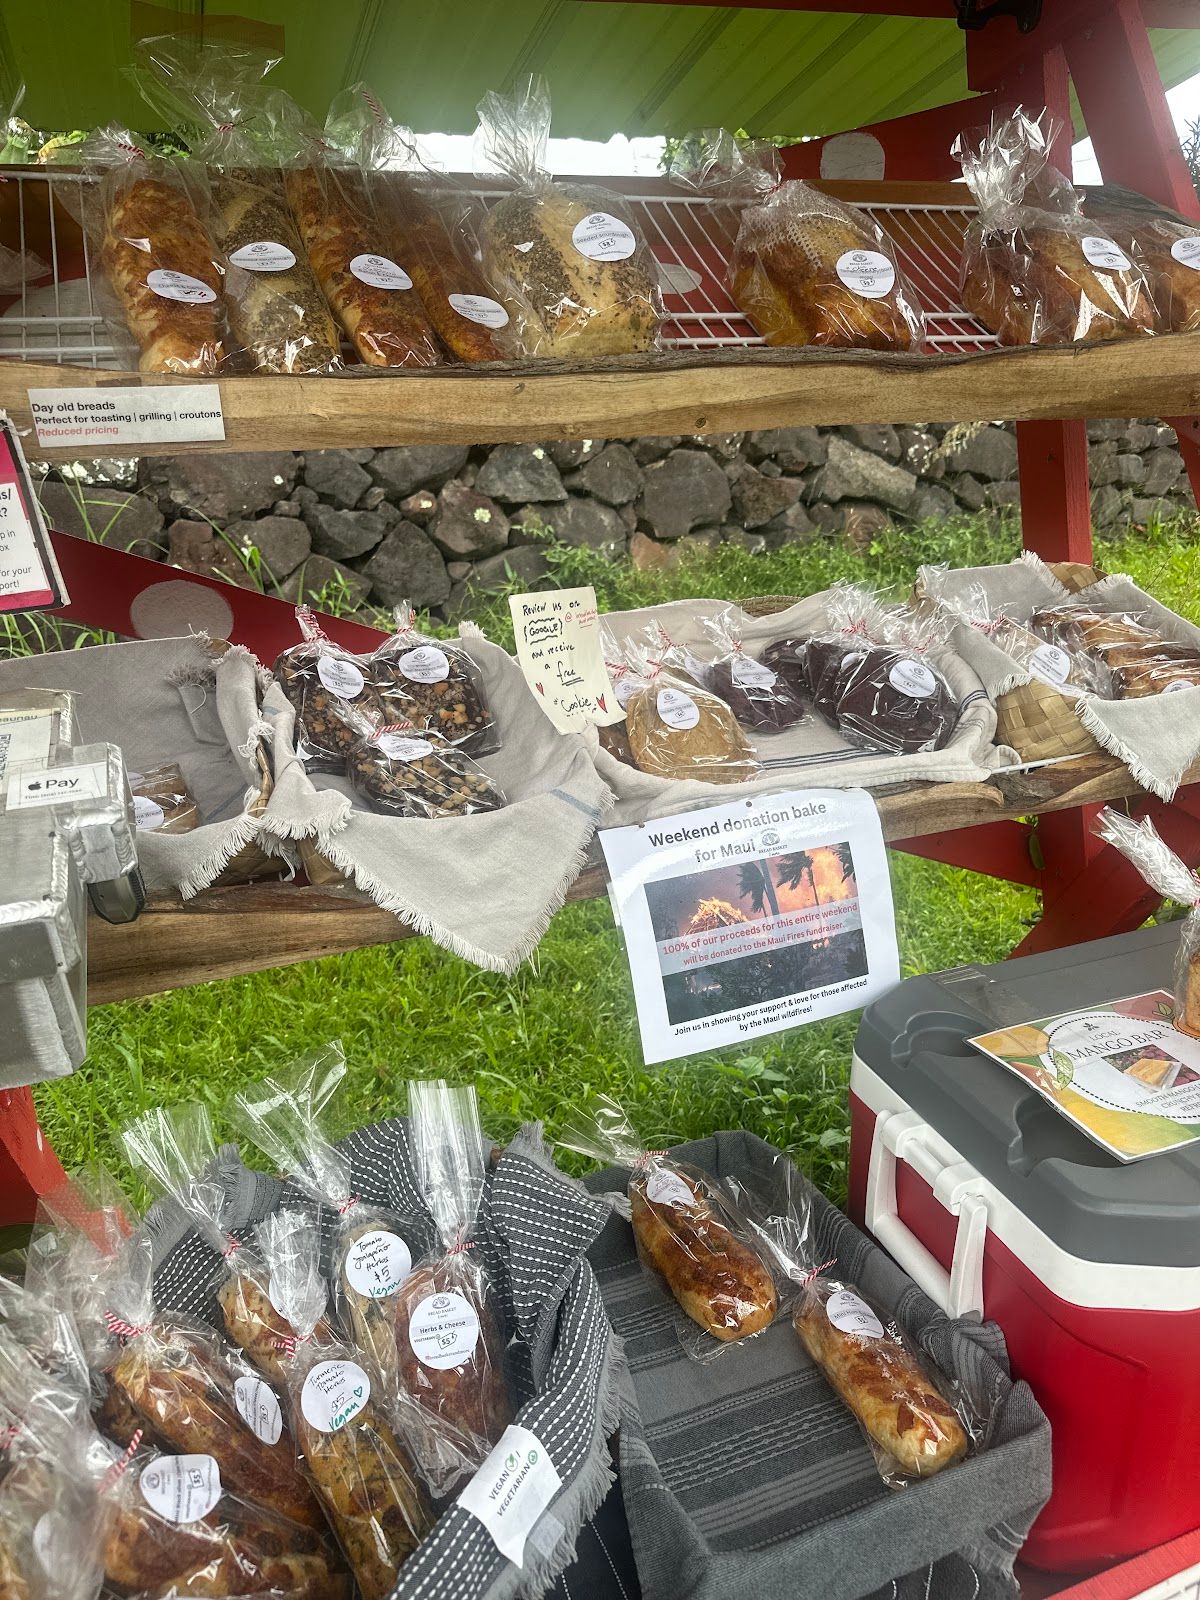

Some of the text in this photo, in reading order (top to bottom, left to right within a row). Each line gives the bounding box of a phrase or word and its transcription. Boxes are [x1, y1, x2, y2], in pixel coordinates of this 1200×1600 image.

[32, 402, 116, 413] Day old breads
[35, 416, 72, 424] Perfect
[75, 415, 88, 423] for
[91, 414, 132, 424] toasting
[139, 412, 172, 422] grilling
[179, 410, 222, 419] croutons
[38, 426, 118, 437] Reduced pricing
[8, 530, 16, 538] in
[12, 567, 32, 578] your
[522, 602, 546, 616] Review
[553, 602, 562, 611] us
[548, 642, 574, 654] receive
[557, 660, 576, 682] free
[46, 778, 78, 788] Pay
[648, 803, 827, 847] Weekend donation bake
[694, 839, 756, 862] for Maui
[664, 902, 858, 954] 100% of our proceeds for this entire weekend
[684, 922, 845, 966] will be donated to the Maui Fires fundraiser.
[674, 1026, 691, 1036] Join
[711, 1014, 741, 1027] showing
[742, 1009, 758, 1020] your
[760, 1002, 786, 1014] support
[794, 996, 808, 1005] love
[821, 988, 840, 997] those
[840, 979, 868, 992] affected
[740, 1005, 812, 1032] by the Maui wildfires!
[1090, 1030, 1120, 1041] LOCAL
[1066, 1030, 1169, 1060] MANGO BAR
[368, 1278, 402, 1296] Vegan
[420, 1326, 438, 1334] Herbs
[444, 1320, 466, 1329] Cheese
[442, 1338, 450, 1346] $5
[328, 1402, 360, 1432] Vegan
[489, 1470, 510, 1500] VEGAN
[497, 1463, 531, 1518] VEGETARIAN
